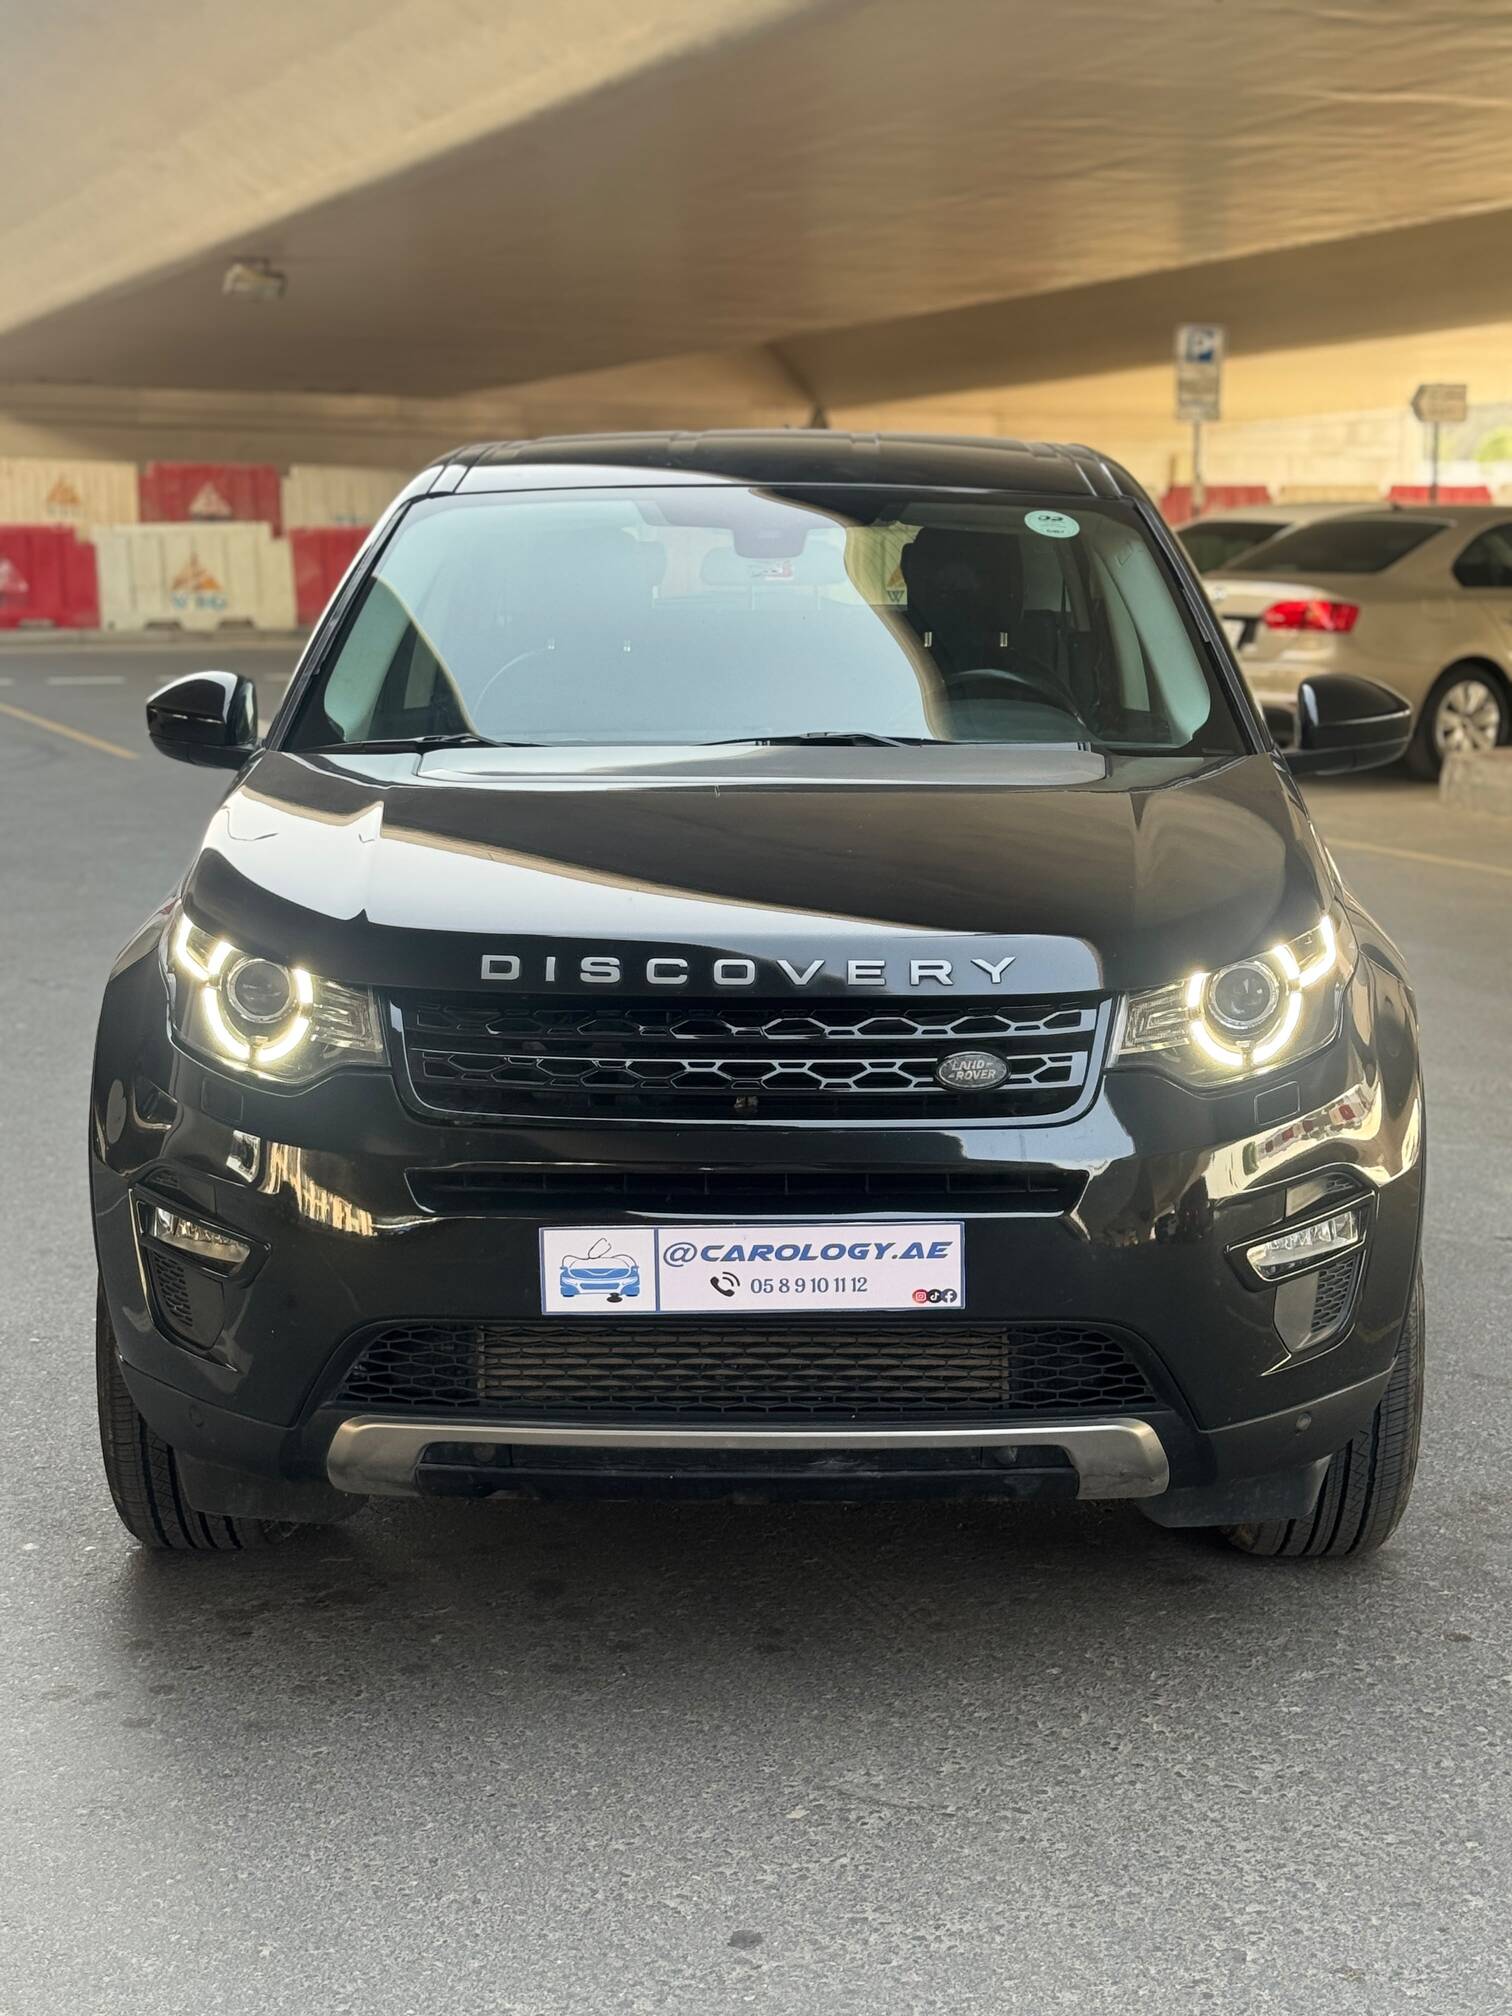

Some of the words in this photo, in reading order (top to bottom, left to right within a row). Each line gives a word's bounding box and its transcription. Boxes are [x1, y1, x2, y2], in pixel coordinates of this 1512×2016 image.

[481, 954, 1016, 986] DISCOVERY
[956, 1069, 997, 1081] ROVER
[662, 1241, 954, 1268] @CAROLOGY.AE
